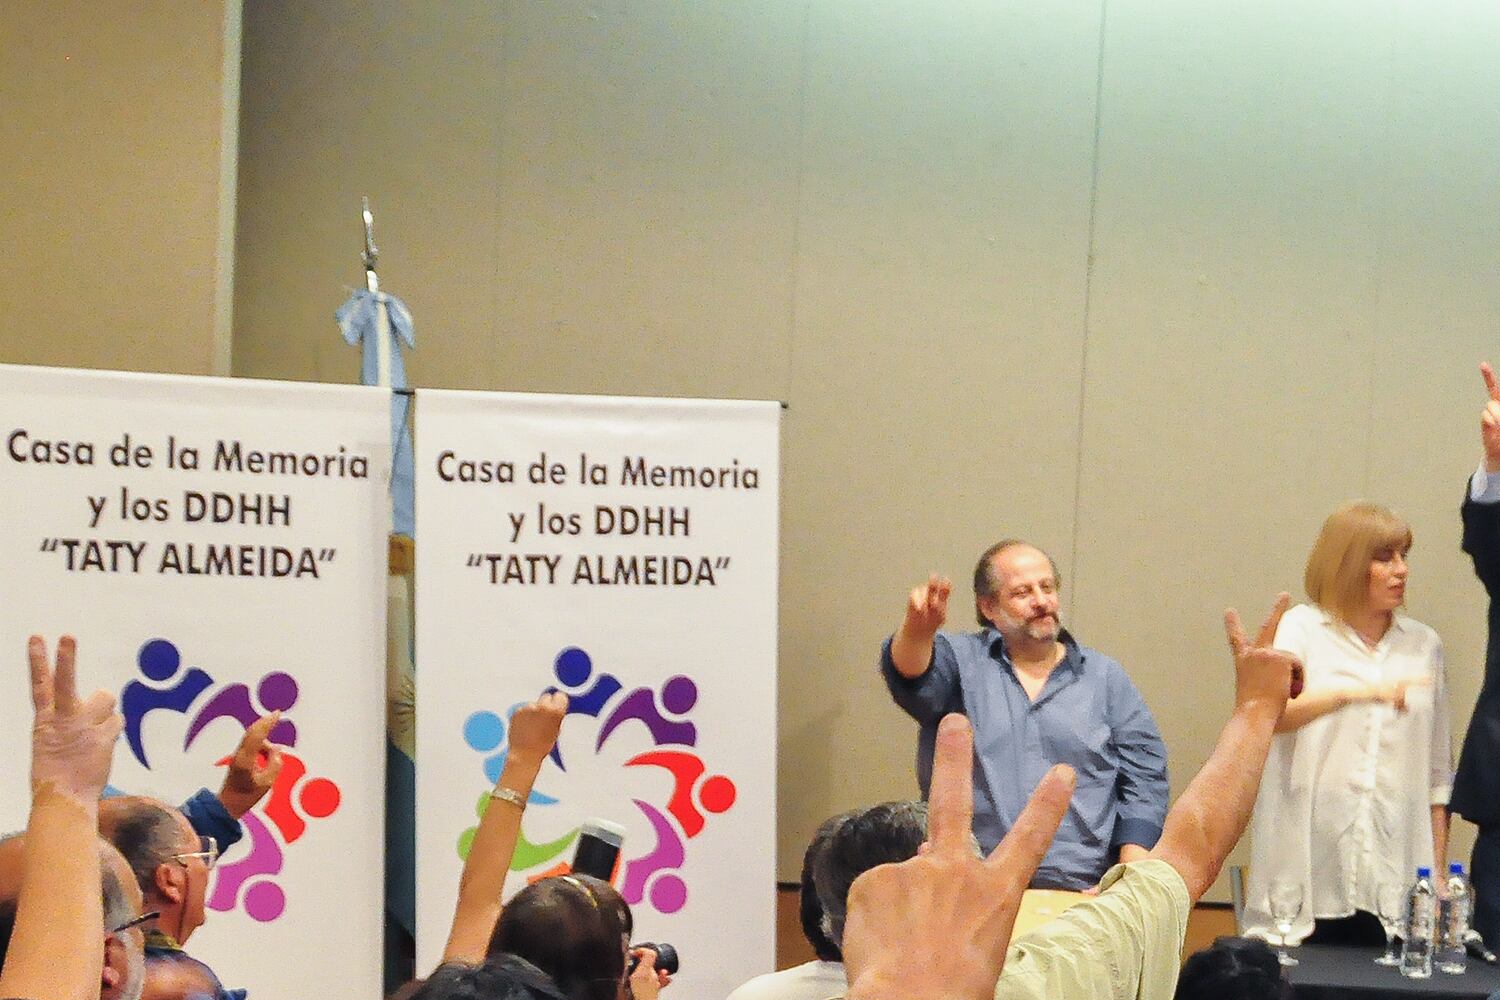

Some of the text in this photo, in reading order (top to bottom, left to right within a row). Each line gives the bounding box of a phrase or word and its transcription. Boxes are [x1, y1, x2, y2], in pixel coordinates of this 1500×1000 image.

[8, 430, 368, 478] Casa de la Memoria
[437, 452, 758, 489] Casa de la Memoria
[88, 487, 290, 528] y los DDHH
[509, 503, 689, 543] y los DDHH
